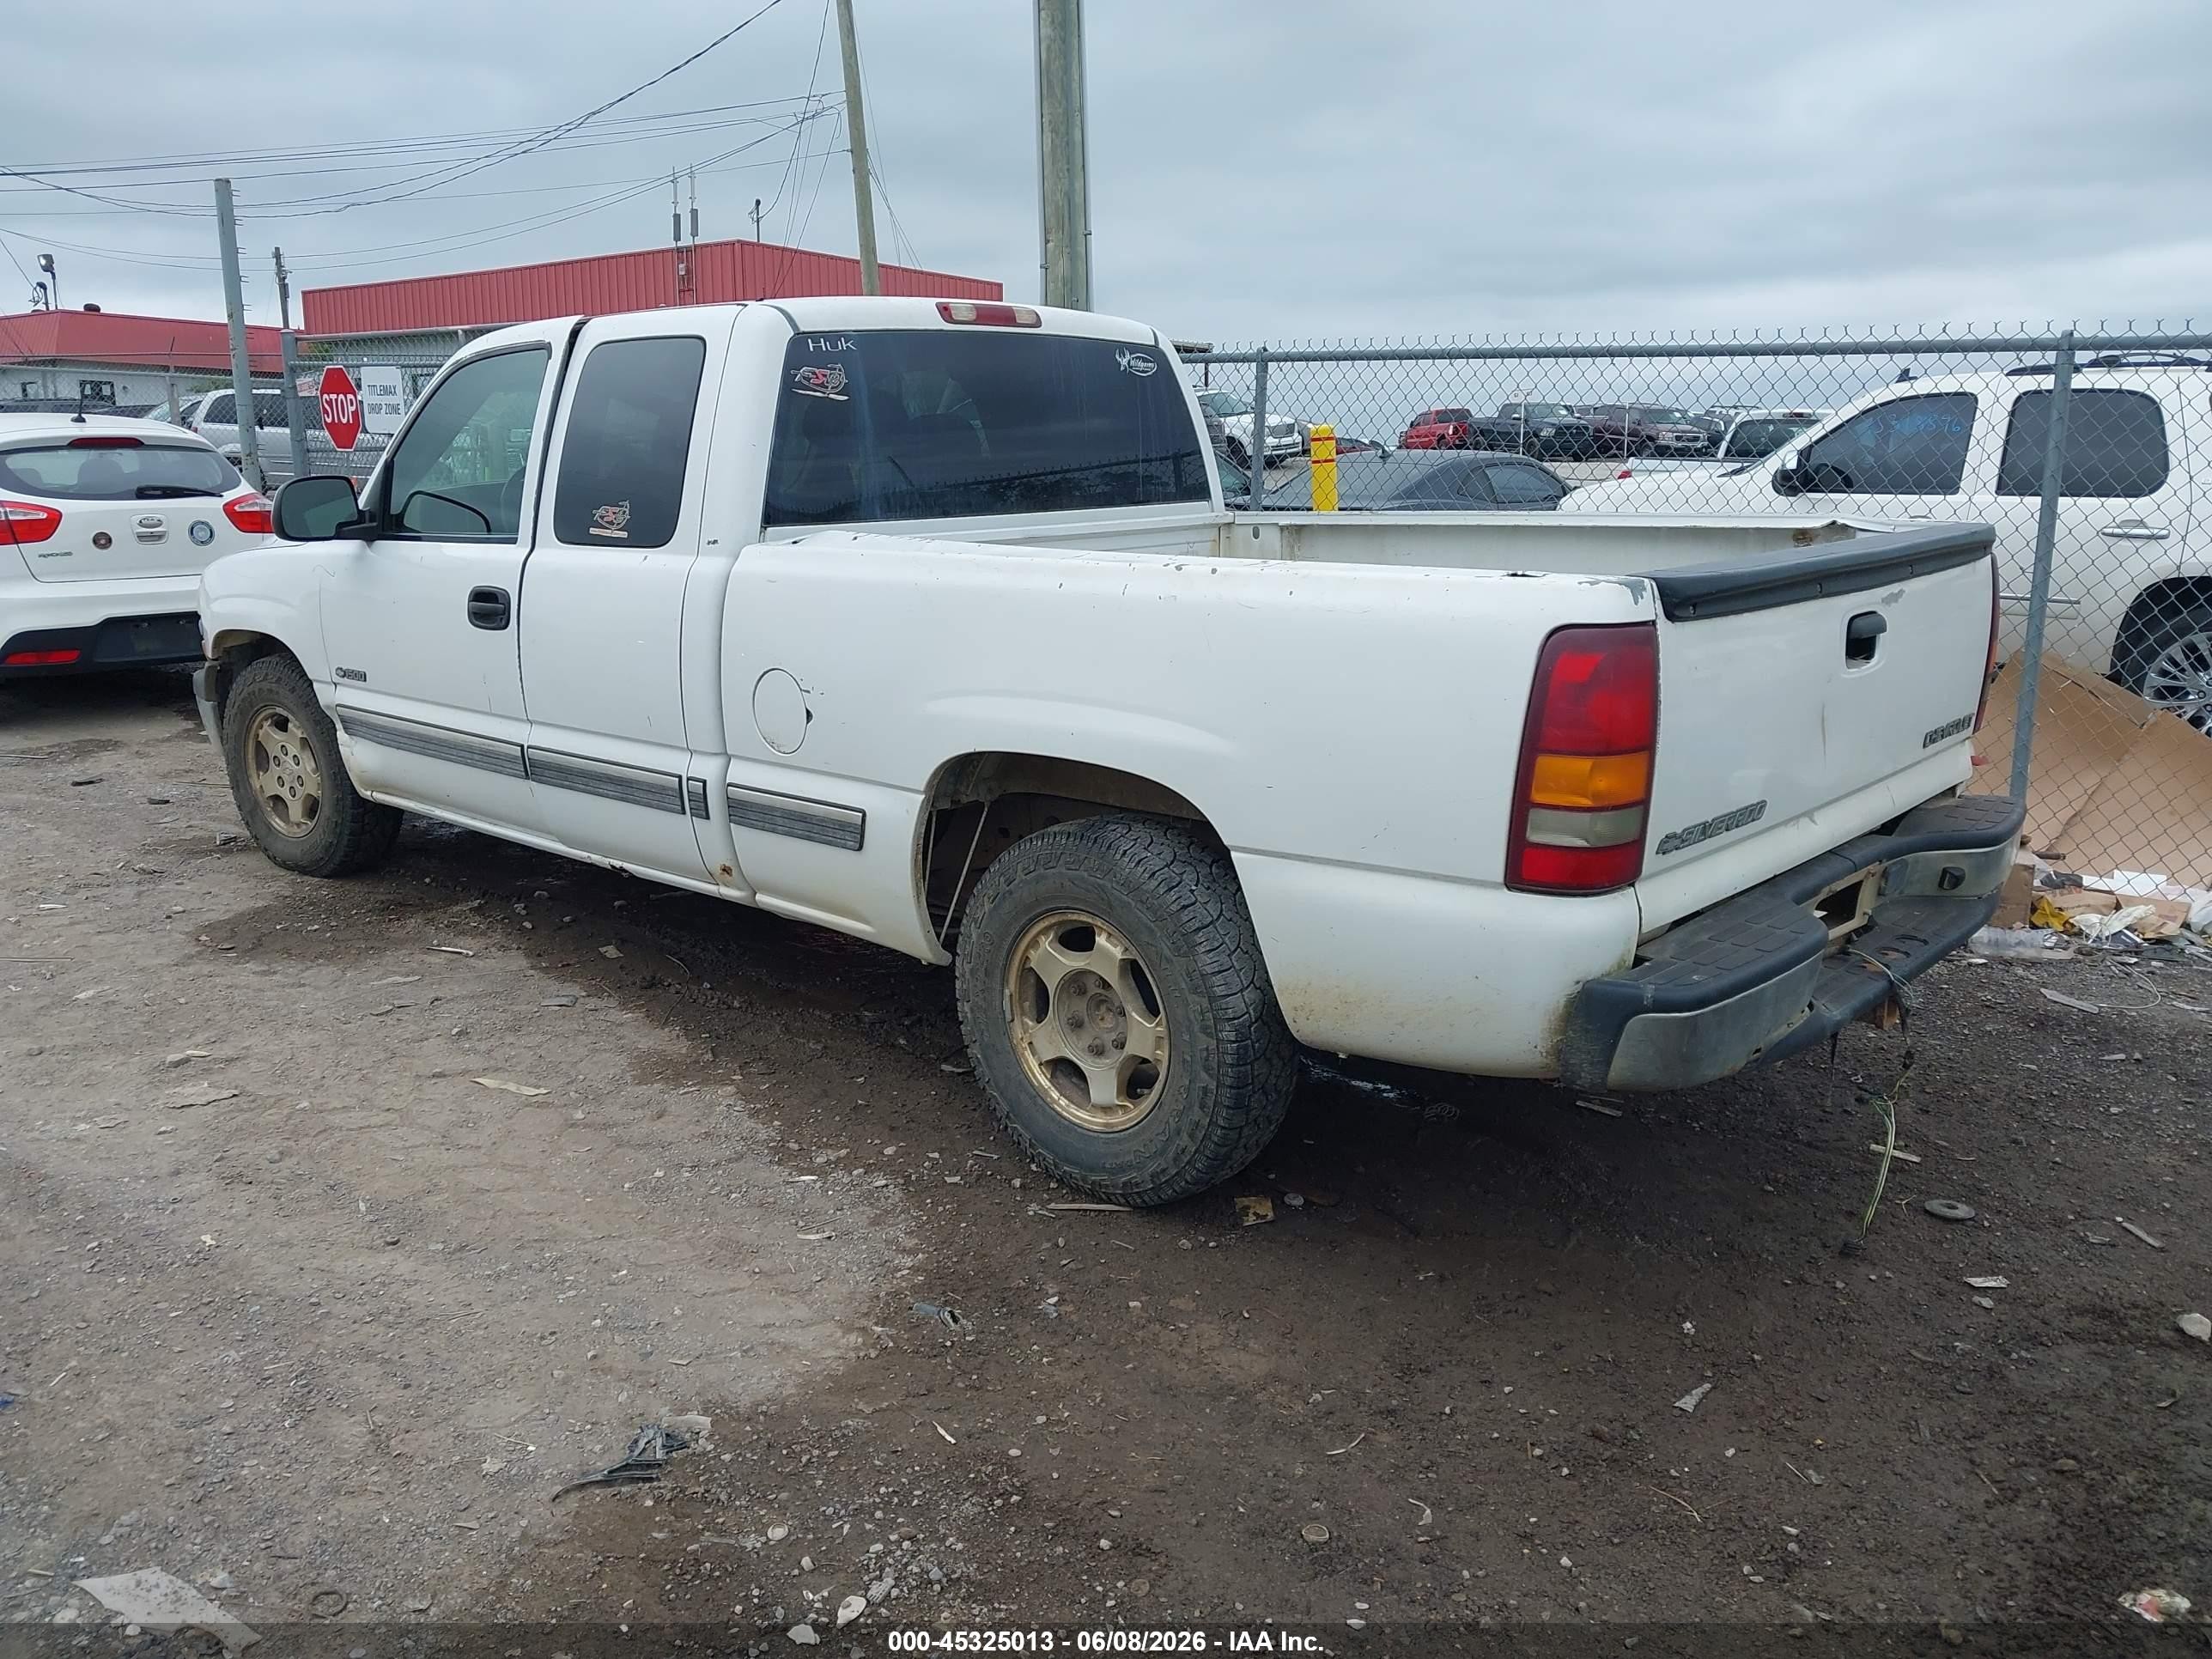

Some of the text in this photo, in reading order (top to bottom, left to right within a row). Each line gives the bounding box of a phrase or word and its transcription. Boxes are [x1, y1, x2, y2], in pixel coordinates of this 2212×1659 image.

[367, 384, 398, 397] TITLEMAX
[322, 393, 356, 424] STOP
[367, 403, 402, 416] DROP ZONE
[1679, 799, 1768, 851] SILVERADO
